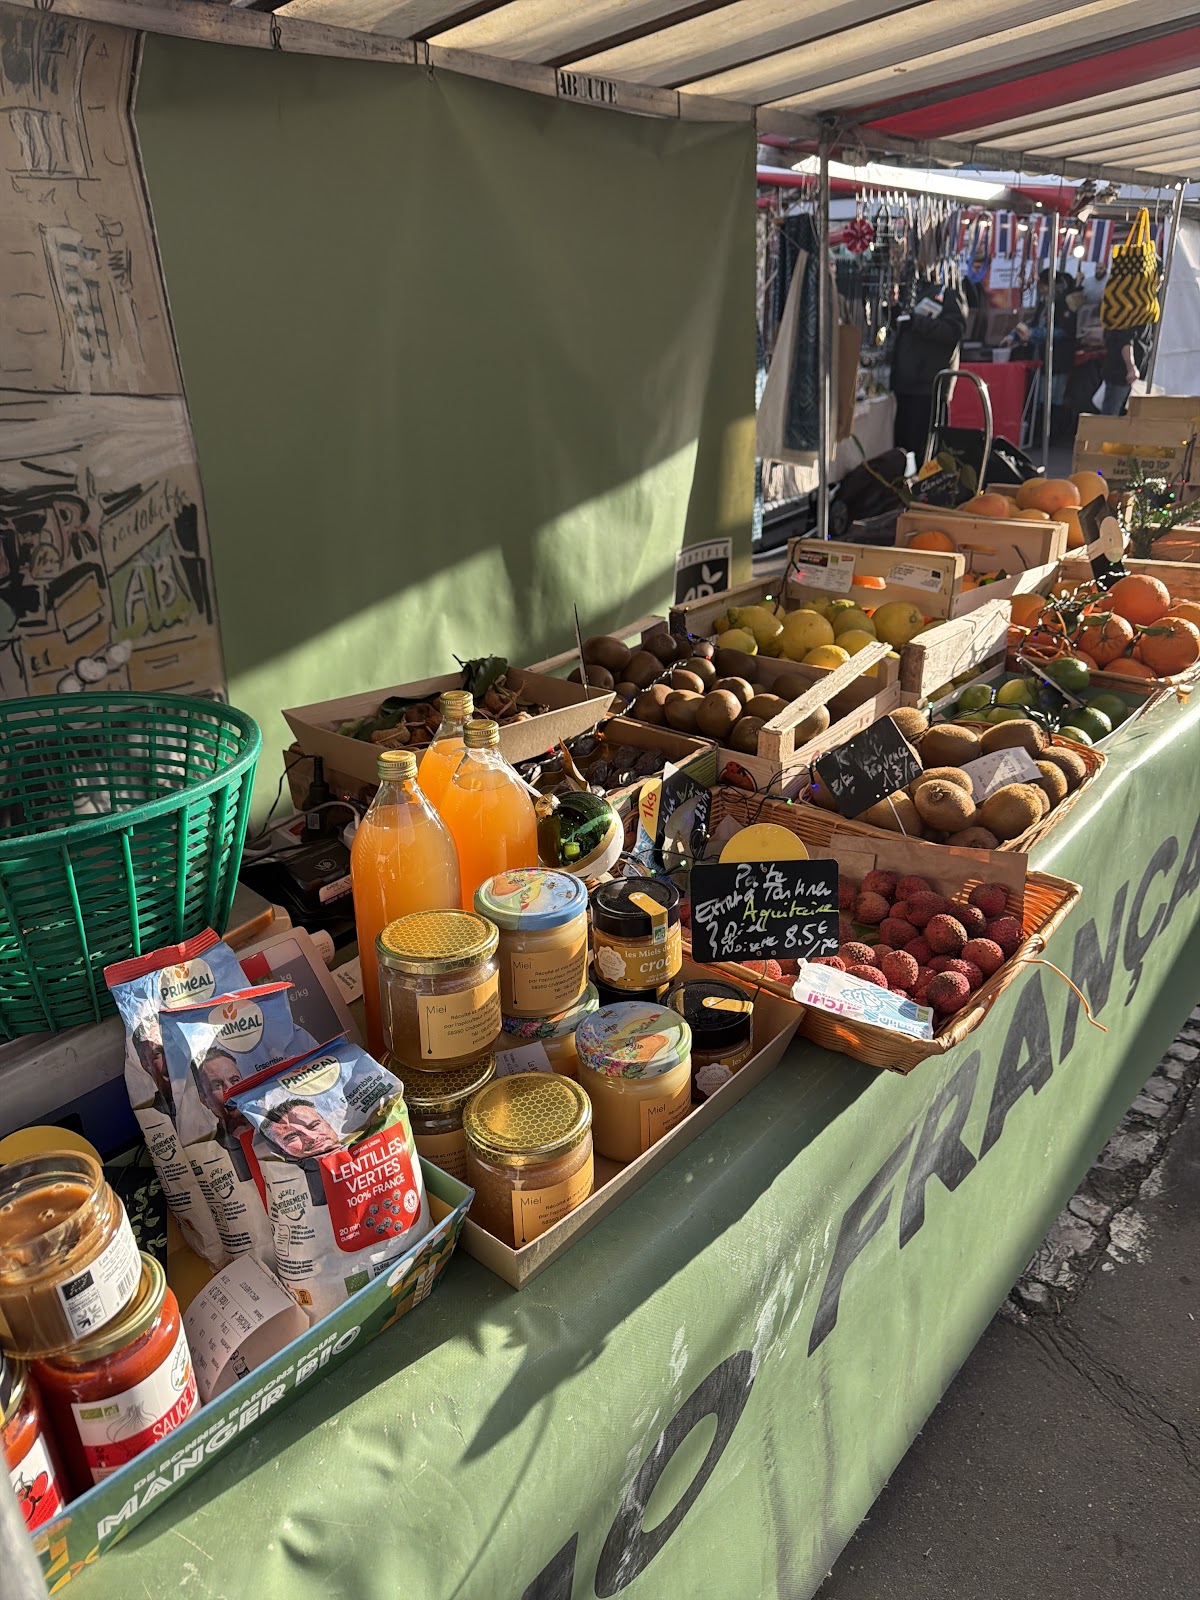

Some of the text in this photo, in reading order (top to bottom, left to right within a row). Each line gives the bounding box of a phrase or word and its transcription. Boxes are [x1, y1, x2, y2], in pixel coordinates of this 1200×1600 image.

[641, 792, 657, 819] 1kg
[639, 948, 661, 958] Miels
[513, 961, 532, 970] Miel
[640, 955, 672, 973] croc
[280, 973, 292, 984] kg
[289, 988, 308, 1002] €/kg
[426, 1005, 447, 1015] Miel
[339, 1075, 373, 1104] Ensemble
[648, 1104, 666, 1116] Miel
[331, 1136, 405, 1184] LENTILLES
[345, 1157, 401, 1194] VERTES
[347, 1173, 406, 1208] 100% FRANCE
[520, 1196, 542, 1206] Miel
[339, 1222, 361, 1236] 20 min
[134, 1331, 338, 1491] DE BONNES RAISONS POUR
[153, 1388, 190, 1439] SAUCE
[97, 1384, 287, 1540] MANGER
[294, 1325, 361, 1387] BIO
